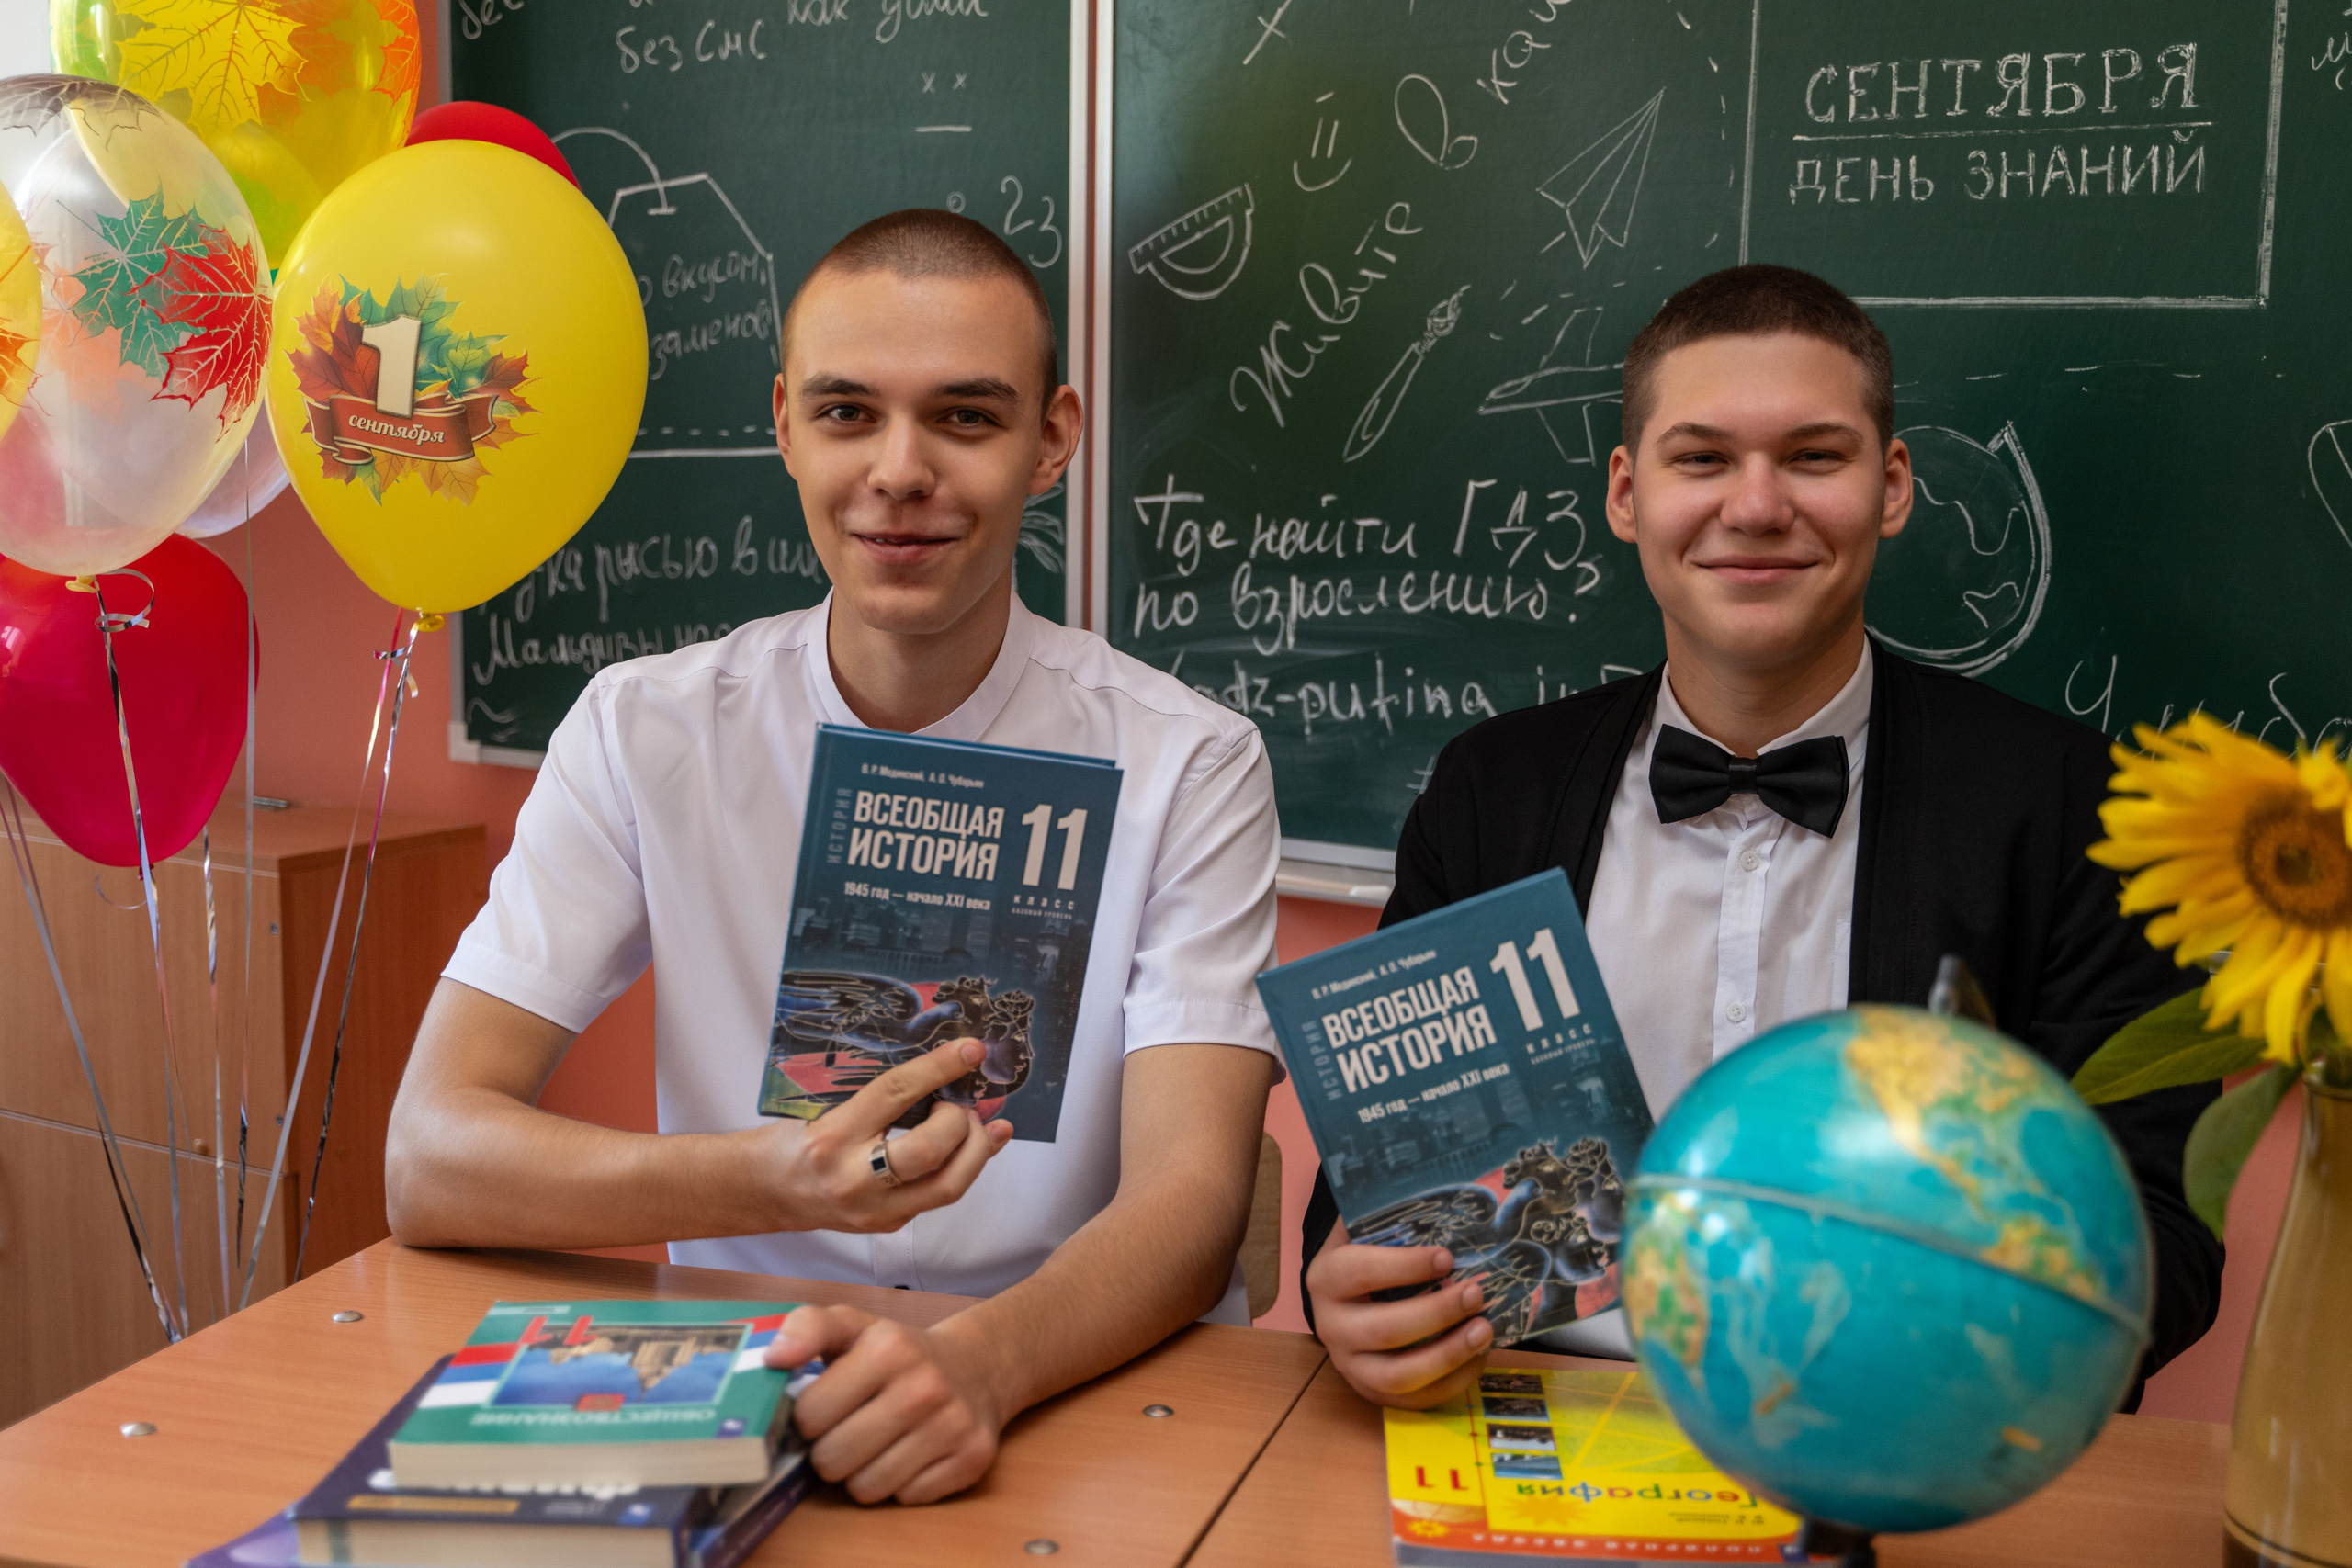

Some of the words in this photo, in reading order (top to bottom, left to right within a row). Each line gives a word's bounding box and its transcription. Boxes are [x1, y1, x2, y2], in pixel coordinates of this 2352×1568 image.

[616, 25, 683, 73] без
[1805, 42, 2198, 123] СЕНТЯБРЯ
[1790, 154, 1934, 204] ДЕНЬ
[1964, 128, 2205, 200] ЗНАНИЙ
[362, 313, 421, 419] 1
[348, 414, 446, 446] сентября
[1250, 494, 1418, 560] найти
[1453, 479, 1587, 570] ГДЗ
[1134, 582, 1199, 638] по
[827, 787, 853, 864] ИСТОРИЯ
[854, 790, 1005, 840] ВСЕОБЩАЯ
[1022, 803, 1088, 891] 11
[847, 827, 1000, 882] ИСТОРИЯ
[843, 881, 869, 897] 1945
[870, 886, 889, 901] год
[906, 891, 944, 906] начало
[966, 897, 991, 910] века
[1321, 966, 1480, 1049] ВСЕОБЩАЯ
[1489, 928, 1581, 1032] 11
[1301, 1020, 1343, 1100] ИСТОРИЯ
[1336, 1003, 1498, 1093] ИСТОРИЯ
[1358, 1102, 1385, 1123] 1945
[1385, 1099, 1408, 1116] год
[1421, 1080, 1462, 1102] начало
[1481, 1063, 1510, 1081] века
[517, 1315, 597, 1346] 11
[1415, 1467, 1469, 1491] 11
[1516, 1481, 1759, 1509] География
